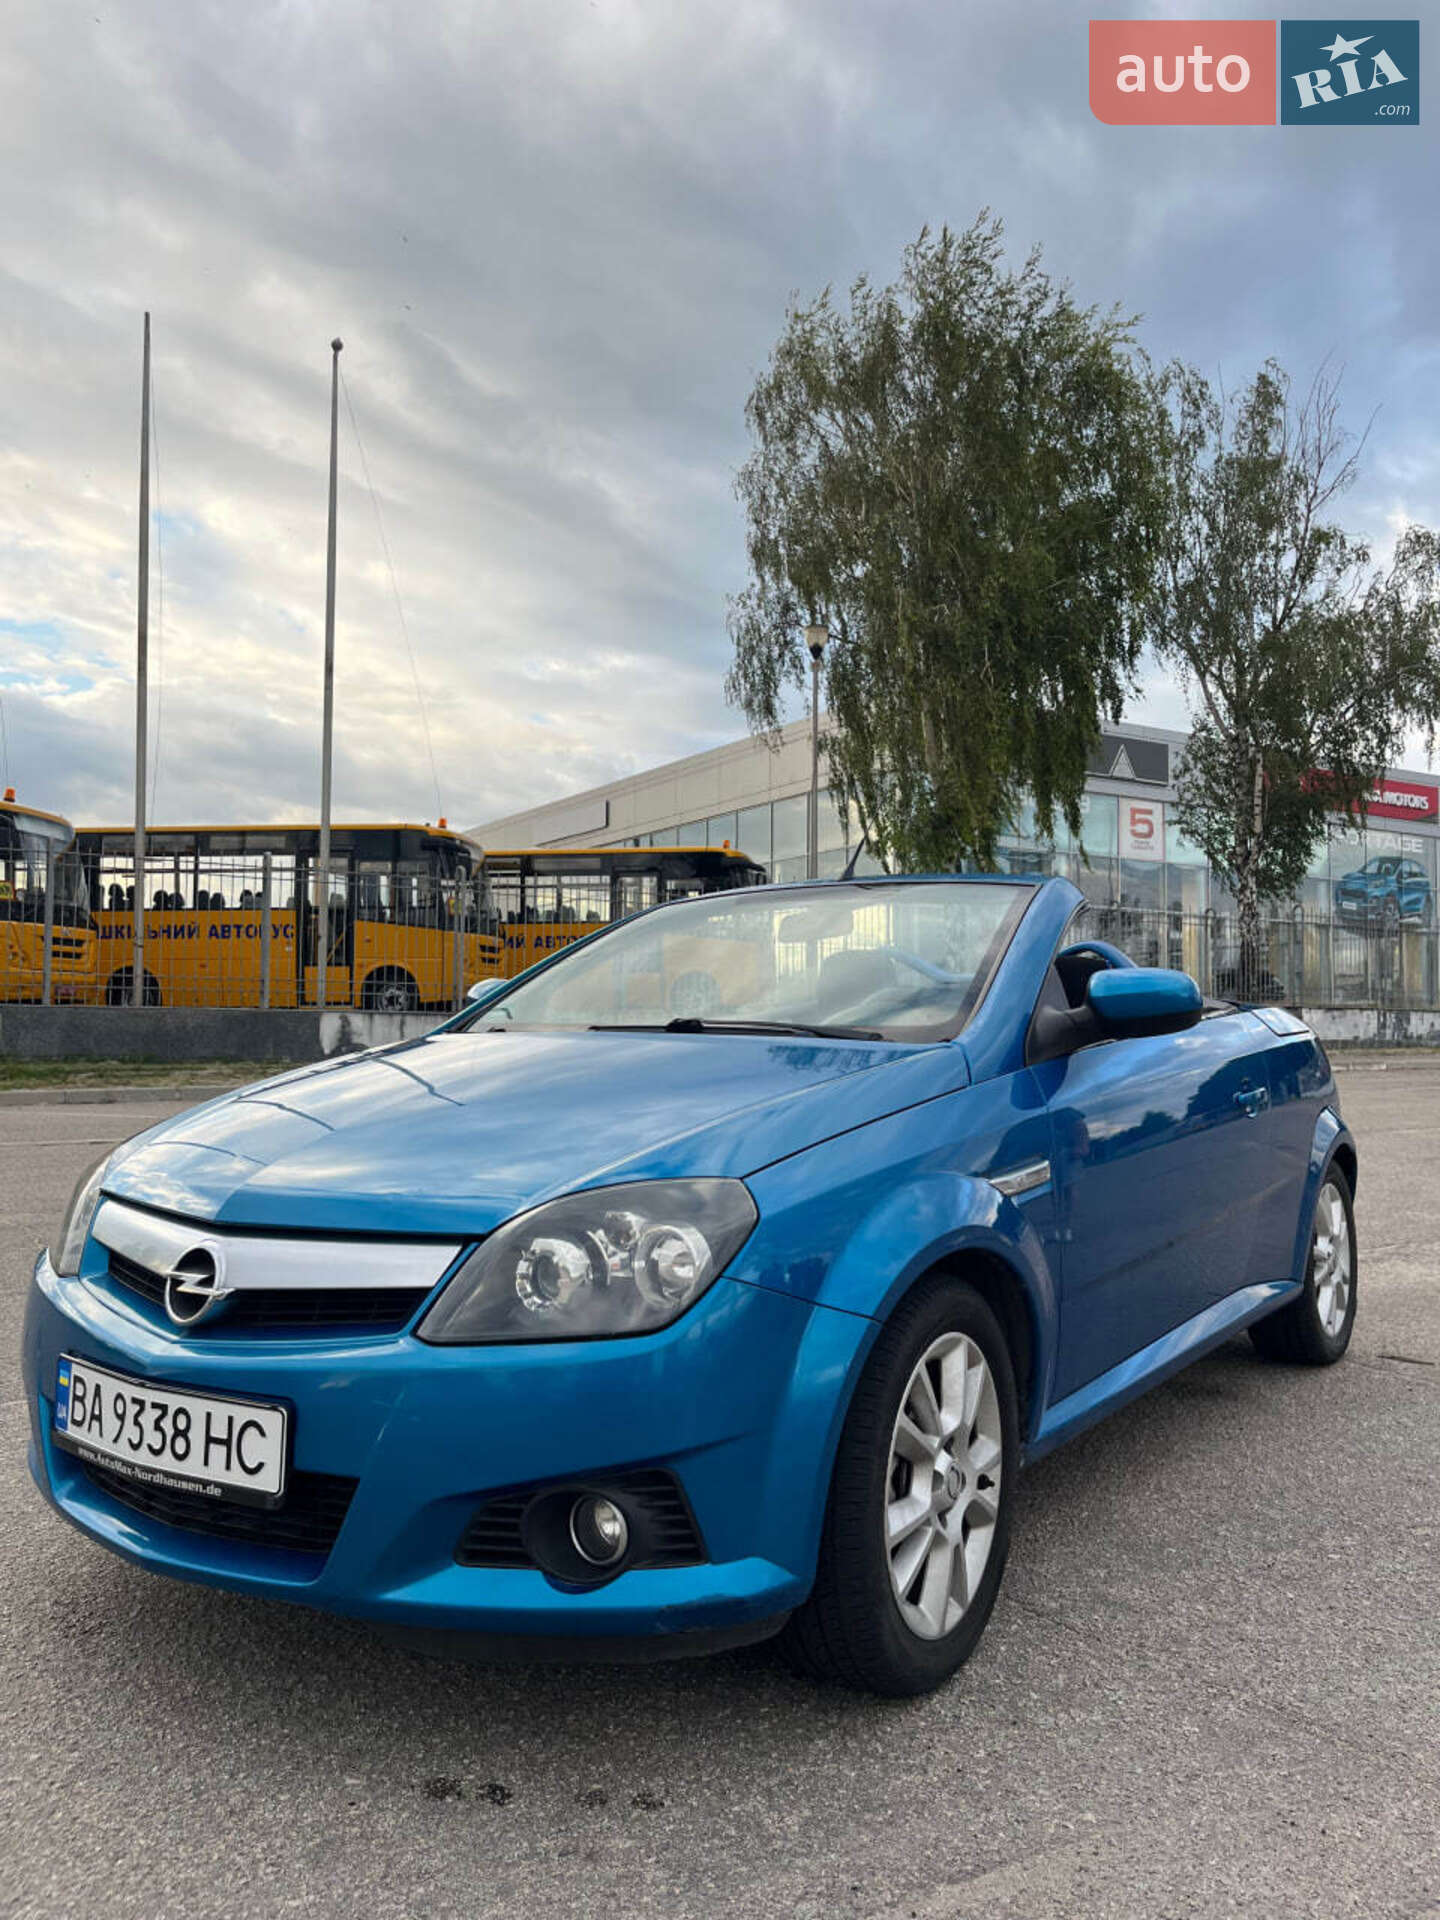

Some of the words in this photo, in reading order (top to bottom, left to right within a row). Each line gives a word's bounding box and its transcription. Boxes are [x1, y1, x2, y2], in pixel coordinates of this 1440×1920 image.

[1382, 791, 1430, 811] MOTORS
[1129, 807, 1154, 839] 5
[96, 922, 200, 940] ШКІЬНИЙ
[208, 923, 294, 940] АВТОУС
[534, 935, 586, 949] АВТО
[70, 1373, 104, 1439] BA
[111, 1391, 192, 1462] 9338
[203, 1410, 267, 1476] HC
